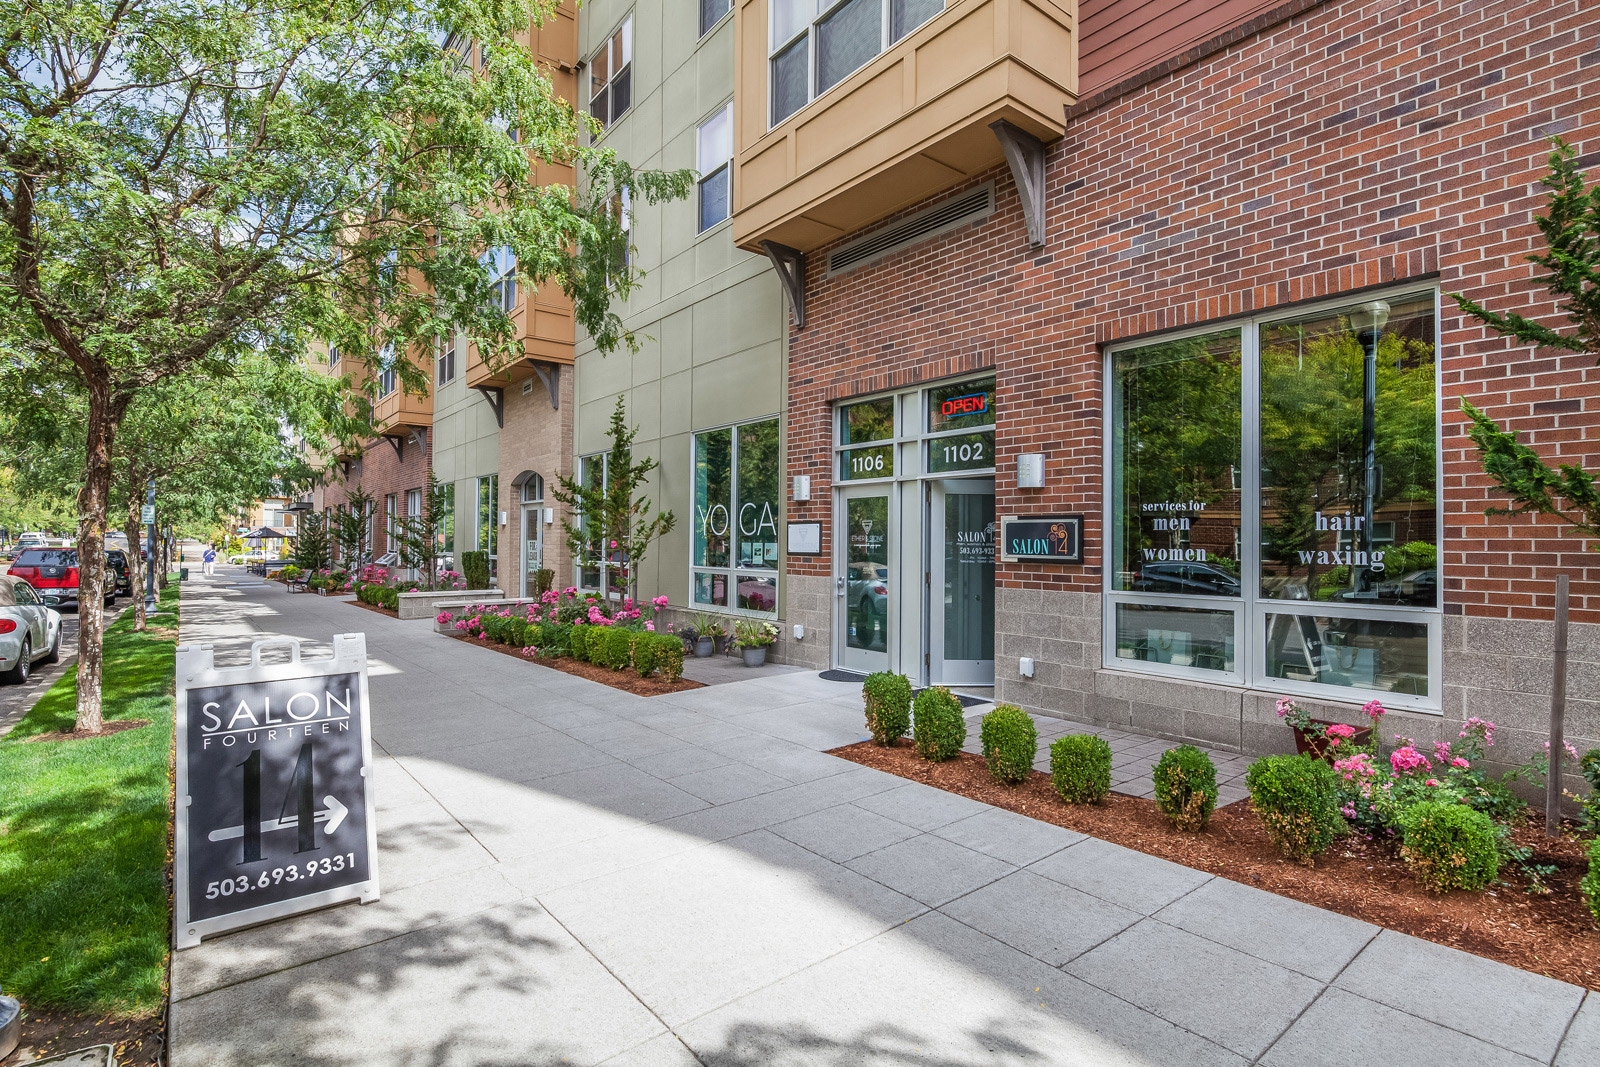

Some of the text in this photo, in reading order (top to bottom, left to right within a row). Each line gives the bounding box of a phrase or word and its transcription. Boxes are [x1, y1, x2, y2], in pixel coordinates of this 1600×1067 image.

[941, 396, 984, 416] OPEN
[943, 442, 984, 463] 1102
[852, 454, 884, 472] 1106
[1142, 500, 1206, 512] services for
[1153, 516, 1190, 531] men
[1315, 511, 1365, 531] hair
[957, 531, 986, 542] SALON
[1012, 523, 1068, 555] SALON 14
[1143, 547, 1207, 562] women
[1297, 545, 1386, 571] waxing
[200, 688, 351, 733] SALON
[203, 720, 350, 750] FOURTEEN
[235, 743, 326, 866] 14
[205, 852, 355, 900] 503.693.9331
